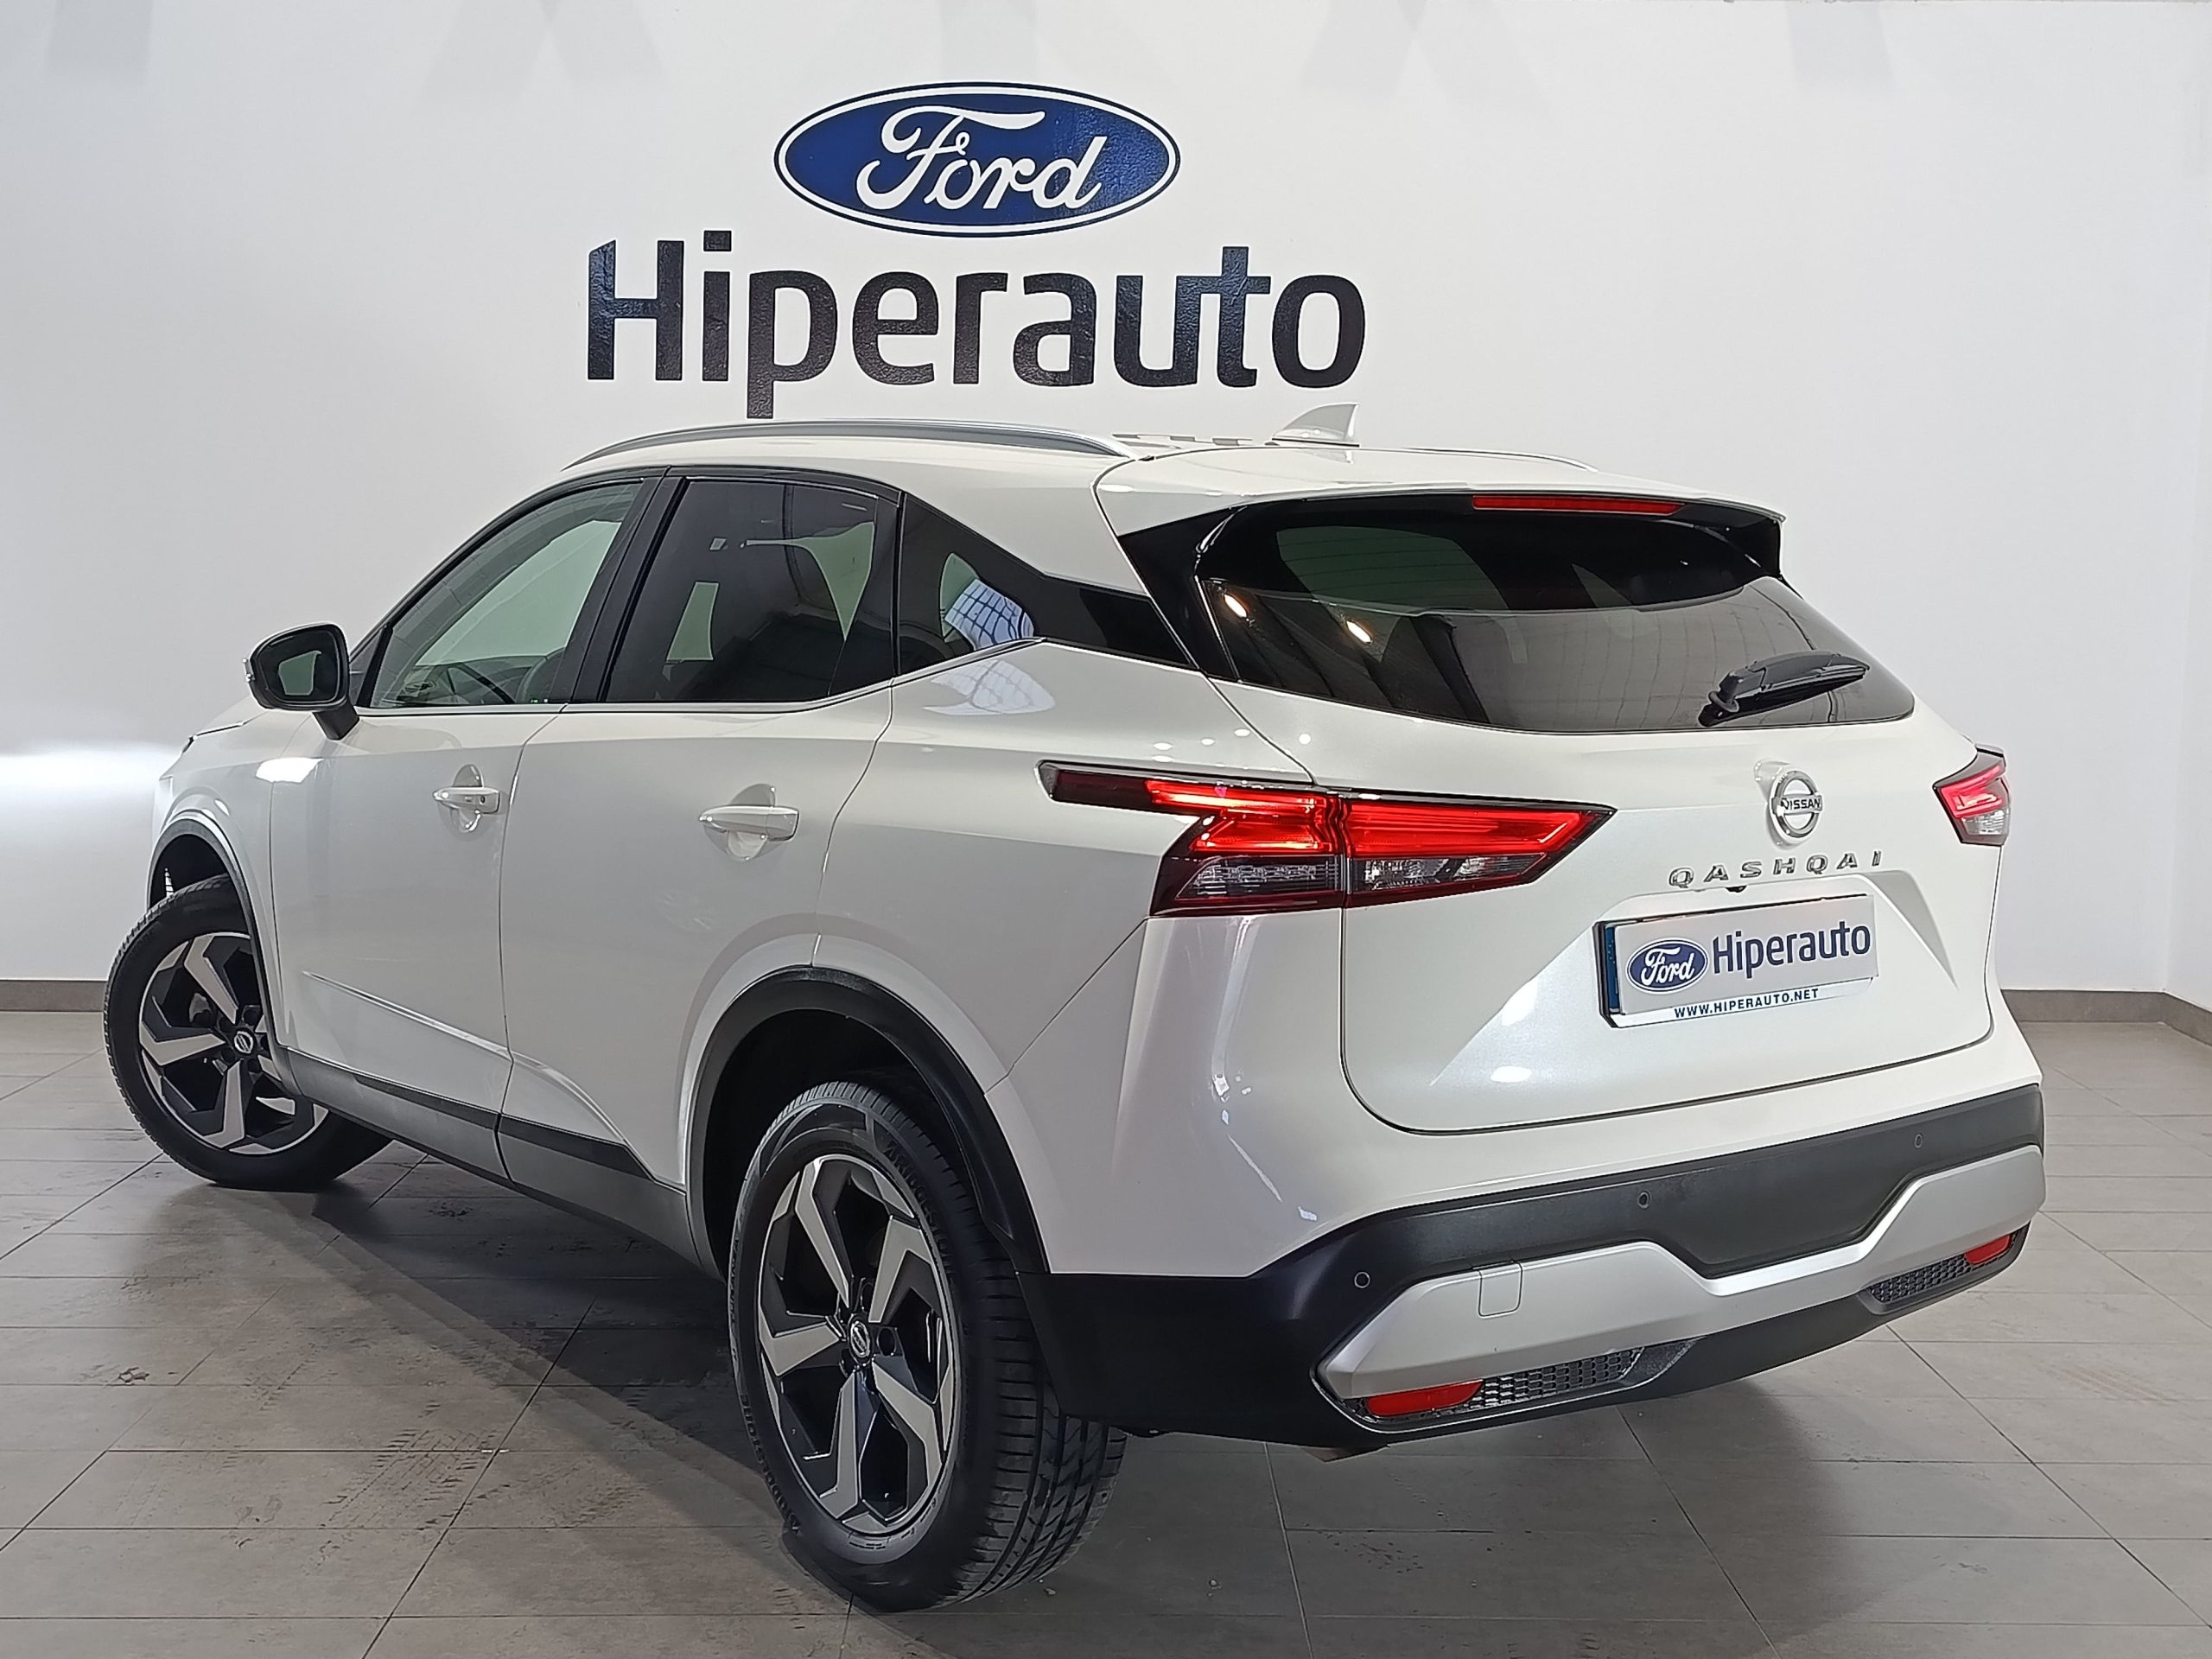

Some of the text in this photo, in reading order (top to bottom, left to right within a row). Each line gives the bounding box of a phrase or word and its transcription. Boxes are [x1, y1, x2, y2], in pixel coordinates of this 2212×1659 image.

[856, 105, 1107, 211] Ford
[587, 230, 1366, 419] Hiperauto
[1781, 797, 1821, 810] NISSAN
[1669, 850, 1882, 888] QASHQAI
[1641, 921, 1872, 986] Ford Hiperauto
[1674, 988, 1820, 1018] WWW.HIPERAUTO.NET
